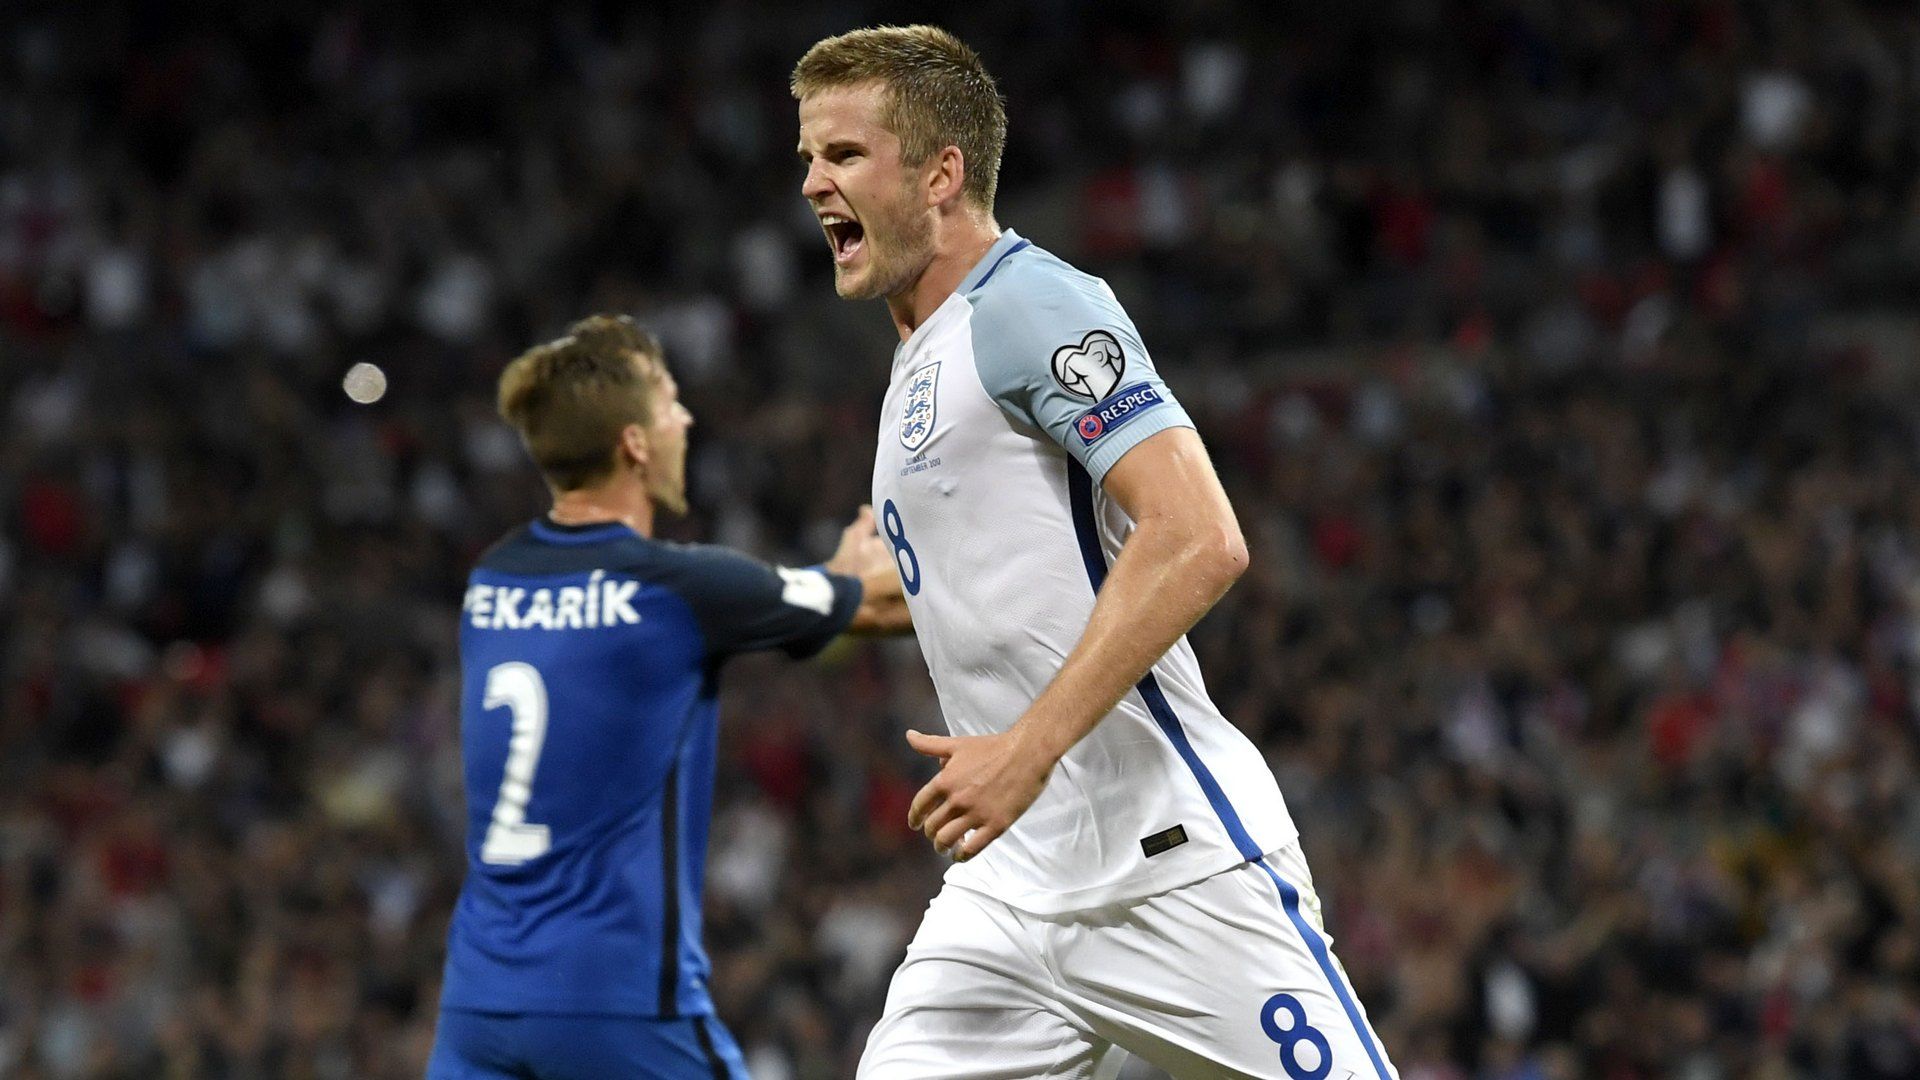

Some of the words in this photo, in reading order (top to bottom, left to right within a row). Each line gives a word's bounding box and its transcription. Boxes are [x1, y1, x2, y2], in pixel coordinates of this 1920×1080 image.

[1100, 388, 1158, 423] RESPECT
[883, 499, 920, 596] 8
[481, 661, 552, 866] 2
[1260, 993, 1333, 1080] 8
